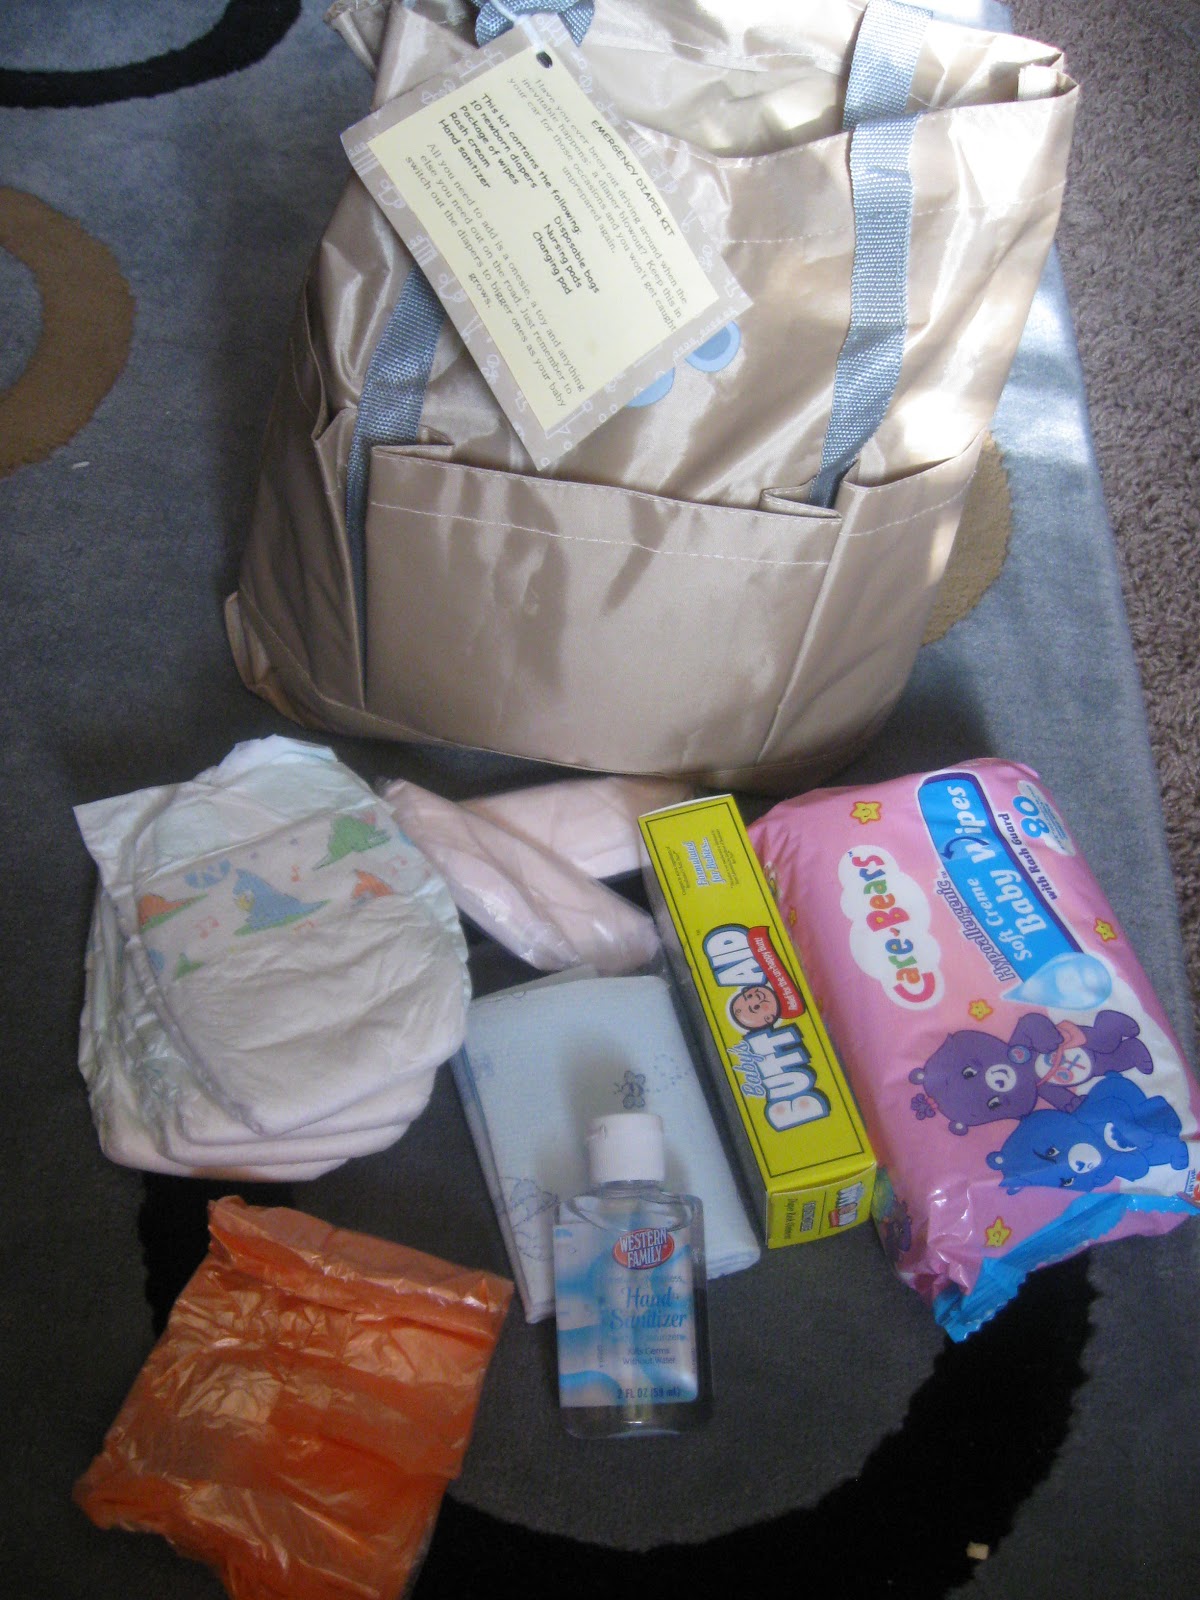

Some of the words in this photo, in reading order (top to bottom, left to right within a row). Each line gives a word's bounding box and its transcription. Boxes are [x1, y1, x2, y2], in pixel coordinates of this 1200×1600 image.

[438, 118, 461, 145] Hand
[457, 145, 492, 190] sanitizer
[448, 111, 470, 136] Rash
[466, 137, 491, 168] cream
[458, 104, 490, 144] Package
[487, 144, 500, 157] of
[496, 157, 520, 185] wipes
[469, 99, 482, 112] 10
[479, 112, 512, 152] newborn
[508, 152, 538, 189] diapers
[480, 93, 499, 114] This
[496, 114, 510, 129] kit
[507, 129, 540, 170] contains
[537, 170, 553, 188] the
[550, 188, 583, 236] following:
[506, 77, 527, 99] your
[526, 101, 541, 117] car
[539, 118, 554, 133] for
[552, 134, 574, 161] those
[572, 162, 607, 210] occasions
[604, 211, 620, 231] and
[615, 232, 630, 252] you
[627, 252, 648, 280] won't
[642, 280, 657, 298] get
[653, 298, 677, 332] caught
[521, 78, 559, 123] inevitable
[557, 123, 591, 166] happens:
[597, 178, 620, 211] diaper
[617, 210, 647, 256] blowout?
[645, 259, 664, 287] Keep
[661, 287, 676, 307] this
[672, 307, 682, 318] in
[534, 79, 556, 103] Have
[553, 105, 570, 123] you
[570, 123, 589, 145] ever
[588, 146, 607, 170] been
[605, 172, 618, 187] out
[617, 188, 642, 224] driving
[638, 224, 663, 259] around
[658, 260, 678, 287] when
[675, 287, 689, 305] the
[561, 166, 601, 221] unprepared
[597, 222, 619, 254] again.
[590, 119, 638, 177] EMERGENCY
[635, 178, 662, 217] DIAPER
[659, 217, 674, 238] KIT
[404, 155, 433, 190] switch
[429, 190, 445, 208] out
[443, 209, 459, 227] the
[455, 227, 485, 268] diapers
[482, 268, 493, 281] to
[490, 280, 514, 316] bigger
[510, 317, 528, 343] ones
[524, 343, 536, 357] as
[532, 357, 551, 382] your
[547, 381, 566, 408] baby
[418, 153, 440, 177] else
[435, 178, 453, 198] you
[450, 198, 473, 224] need
[469, 225, 485, 243] out
[481, 244, 494, 259] on
[491, 260, 506, 278] the
[502, 279, 523, 307] road.
[518, 306, 536, 329] Just
[532, 330, 566, 383] remember
[562, 382, 573, 395] to
[426, 141, 442, 158] All
[437, 159, 455, 180] you
[453, 180, 475, 206] need
[472, 206, 484, 219] to
[480, 219, 498, 239] add
[494, 239, 505, 251] is
[534, 308, 548, 327] toy
[545, 327, 561, 347] and
[556, 348, 586, 393] anything
[531, 229, 560, 276] Changing
[556, 275, 572, 295] pad
[543, 223, 568, 265] Nursing
[564, 264, 583, 288] pads
[552, 215, 588, 269] Disposable
[583, 268, 600, 295] bags
[467, 272, 494, 308] grows.
[947, 786, 997, 864] Wipes
[998, 813, 1022, 846] Guard
[1012, 796, 1050, 838] 80
[682, 841, 709, 888] Formulated
[710, 871, 726, 884] for
[852, 855, 910, 932] Bears
[1020, 847, 1041, 875] Rash
[1036, 876, 1058, 900] with
[936, 880, 1016, 982] Hypoallergenic
[967, 878, 1004, 926] Creme
[990, 870, 1046, 935] Baby
[703, 925, 767, 986] AID
[885, 938, 936, 1003] Care
[999, 929, 1032, 962] Soft
[778, 976, 787, 988] the
[783, 986, 792, 996] for
[727, 1040, 766, 1098] Baby's
[747, 1025, 829, 1132] BUTT
[620, 1227, 668, 1252] WESTERN
[628, 1247, 662, 1268] FAMILY
[610, 1308, 686, 1330] Sanitizer
[626, 1286, 672, 1309] Hand
[626, 1388, 635, 1398] FL
[637, 1388, 648, 1398] OZ
